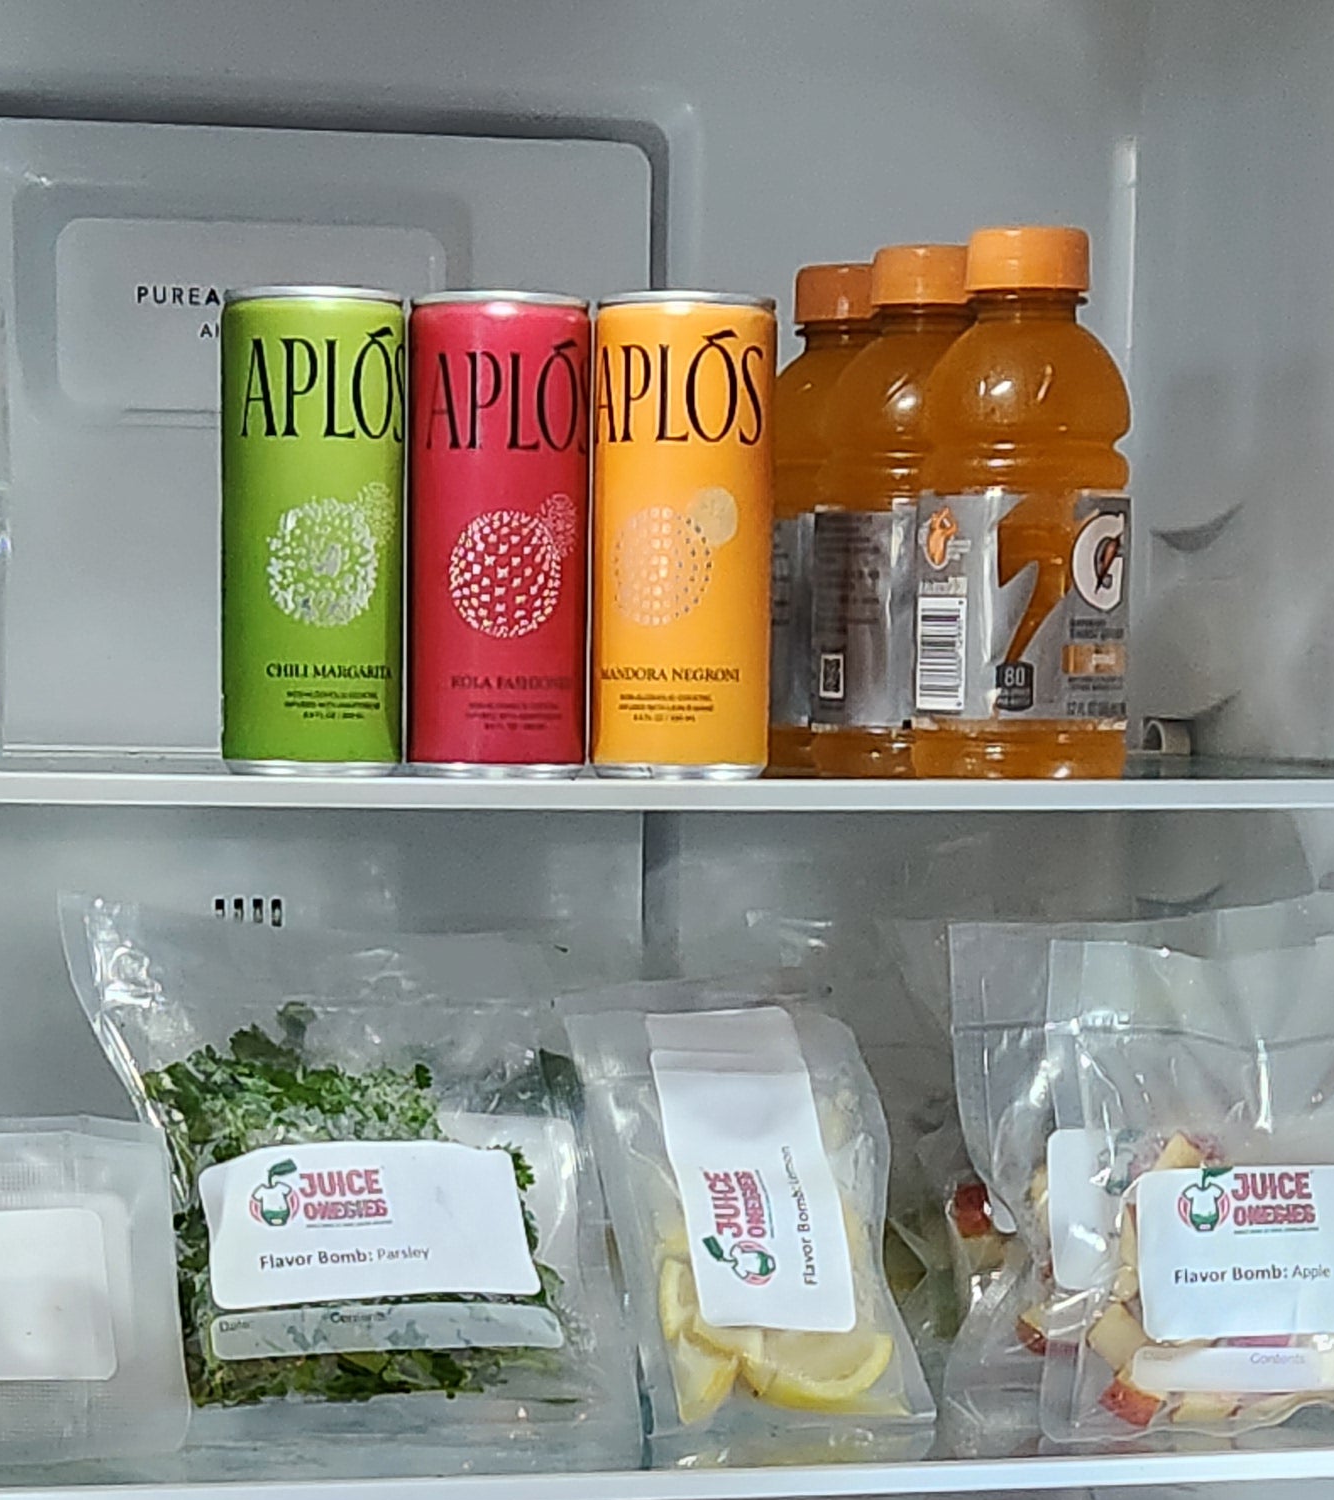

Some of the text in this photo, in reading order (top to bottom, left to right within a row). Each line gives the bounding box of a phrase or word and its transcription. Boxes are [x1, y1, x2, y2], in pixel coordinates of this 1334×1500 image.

[136, 286, 220, 304] PUREA
[426, 339, 586, 452] APLÓ
[595, 327, 765, 446] APLÓS
[266, 663, 393, 680] CHILI MARGARITA
[672, 667, 740, 682] NEGRONI
[1003, 666, 1026, 687] 80
[299, 1169, 384, 1199] JUICE
[1231, 1172, 1312, 1201] JUICE
[704, 1170, 743, 1238] JUICE
[1233, 1204, 1316, 1225] ONESIES
[260, 1246, 430, 1270] Flavor Bomb: Parsley
[802, 1237, 818, 1286] Flavor
[1174, 1265, 1331, 1284] Flavor Bomb: Apple
